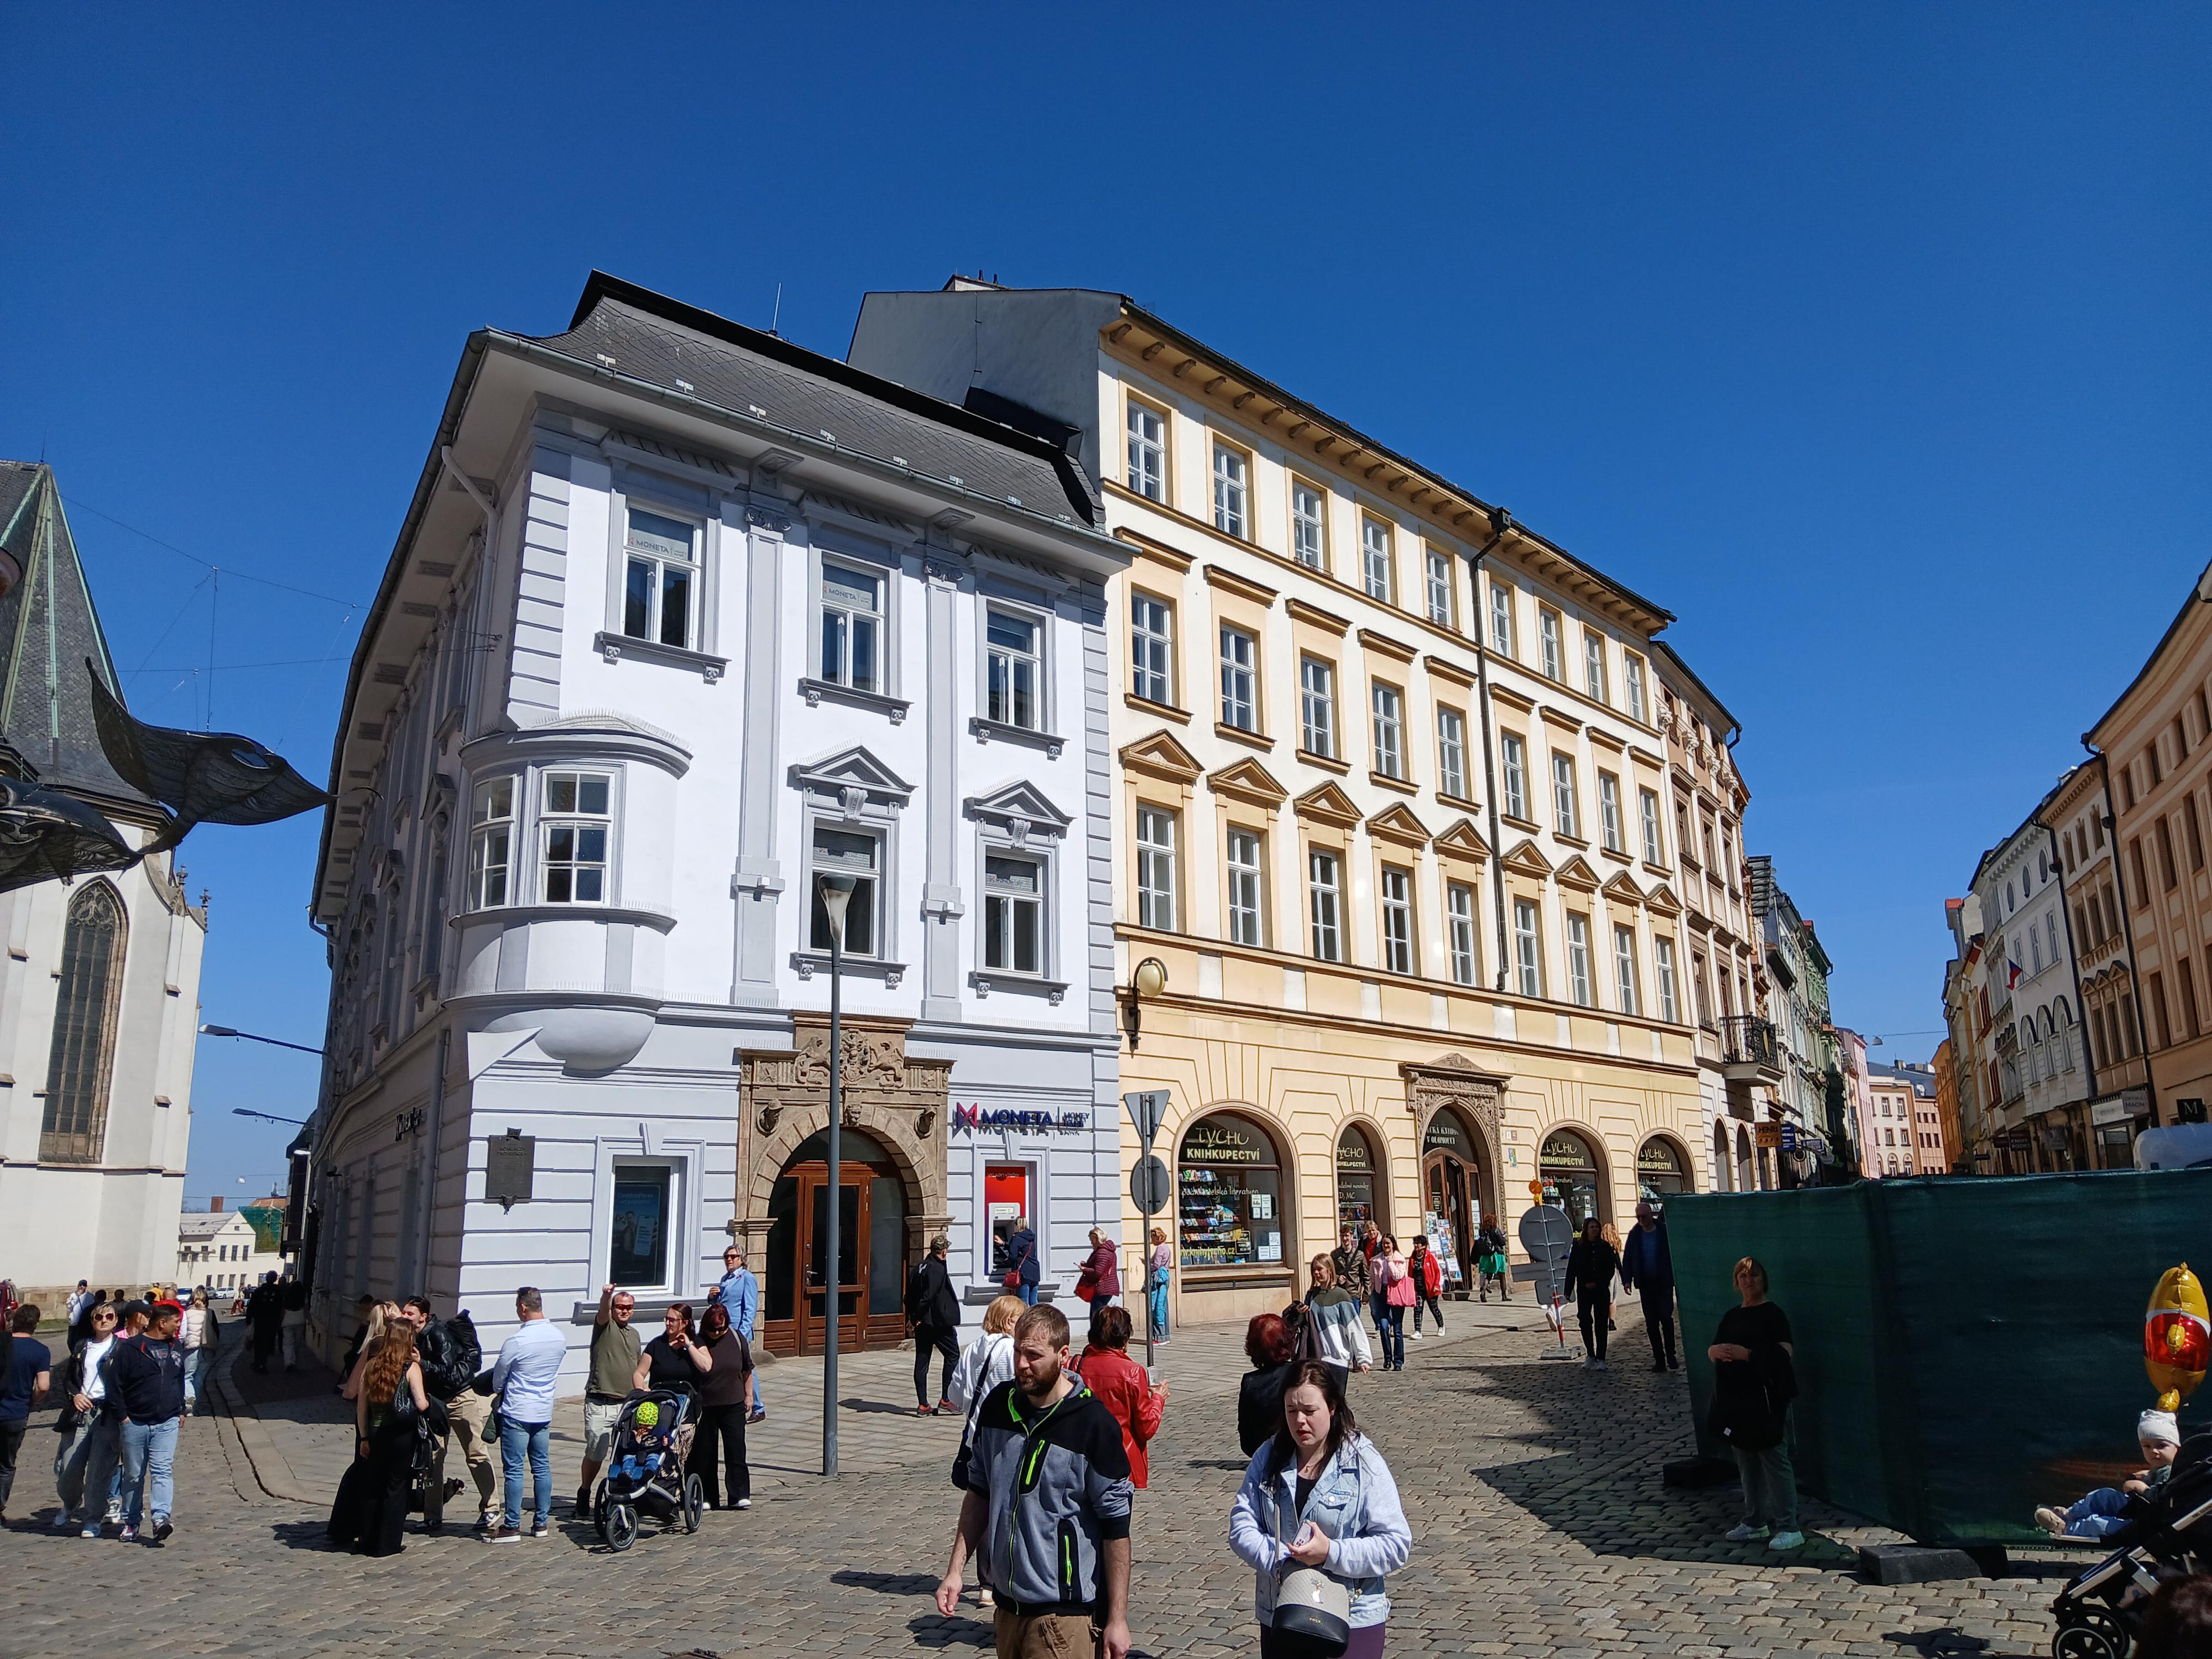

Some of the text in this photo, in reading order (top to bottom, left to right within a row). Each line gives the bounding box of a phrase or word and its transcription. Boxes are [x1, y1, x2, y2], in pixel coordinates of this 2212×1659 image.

[636, 539, 669, 554] MONETA
[828, 588, 857, 601] MONETA
[2184, 1101, 2198, 1115] M
[982, 1108, 1053, 1125] MONETA
[1187, 1147, 1260, 1161] KNIHKUPECTVÍ
[1337, 1146, 1364, 1160] YCHO
[1540, 1155, 1584, 1166] KNIHKUPECTVÍ
[1229, 1185, 1259, 1195] literatura
